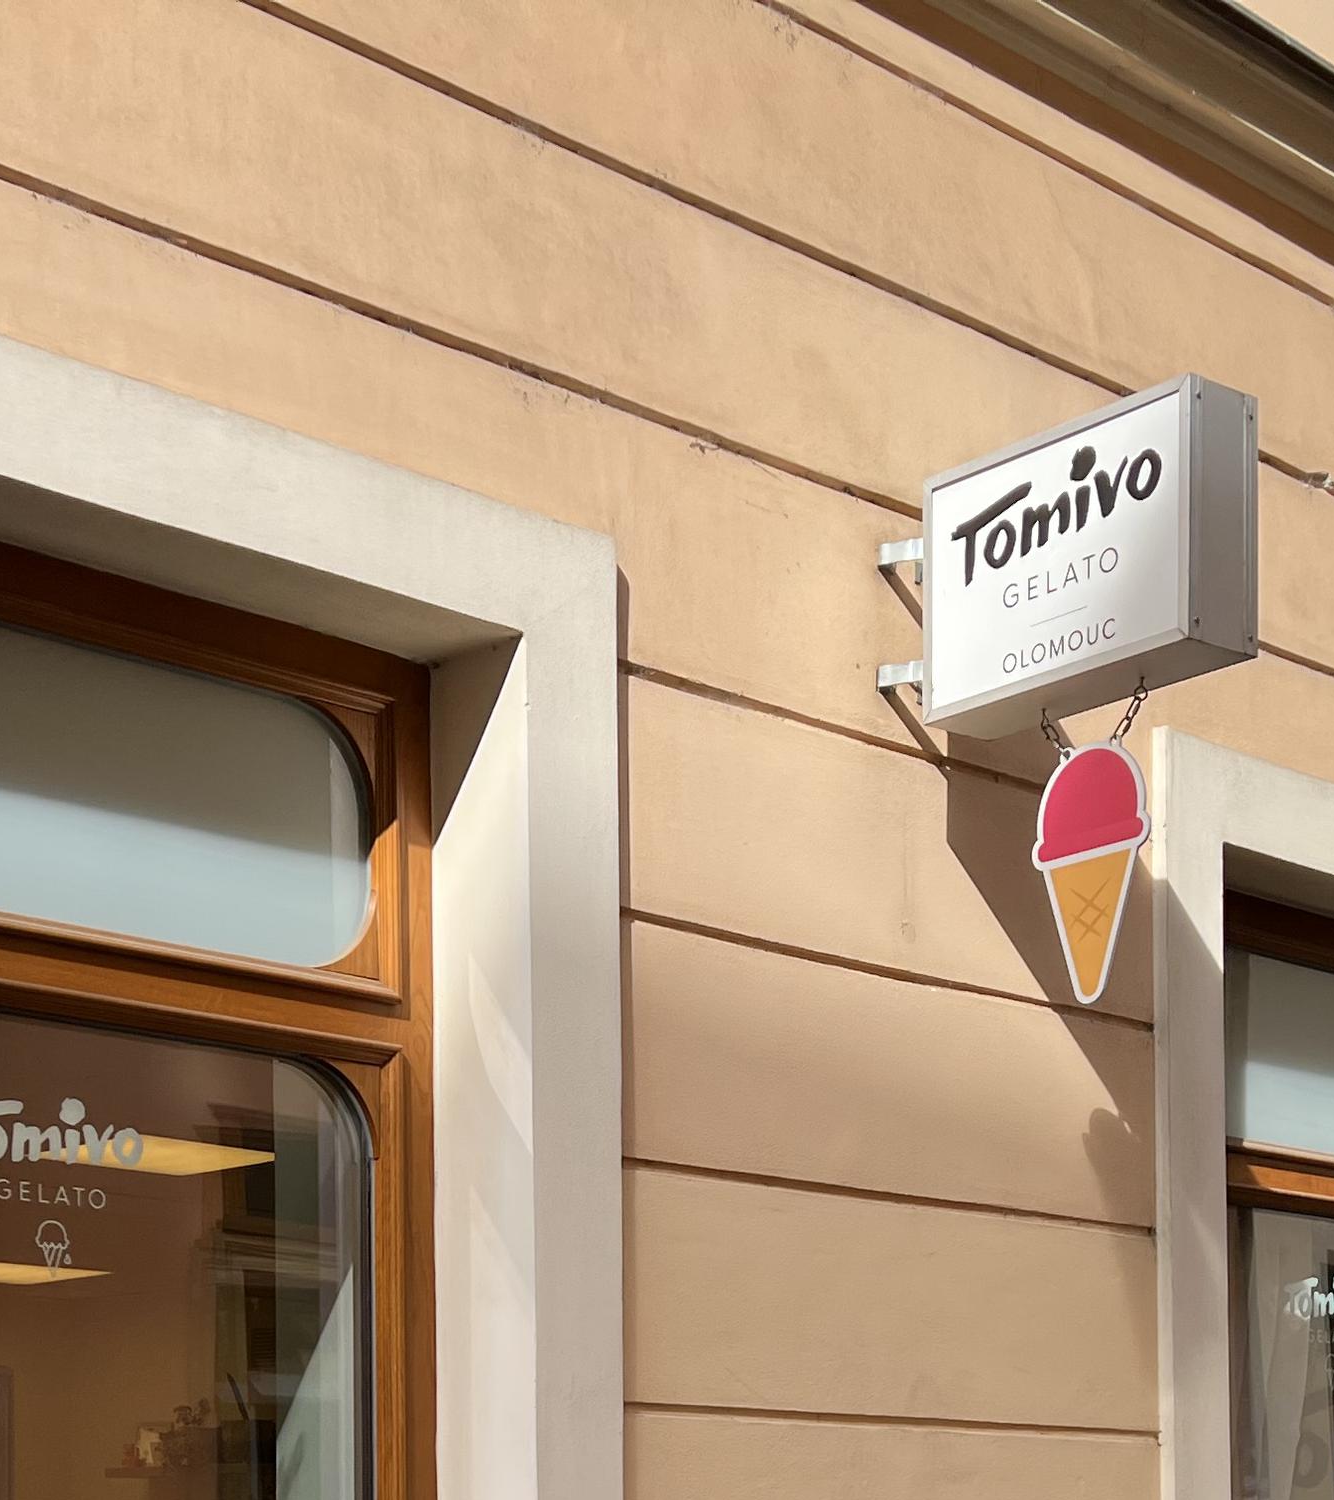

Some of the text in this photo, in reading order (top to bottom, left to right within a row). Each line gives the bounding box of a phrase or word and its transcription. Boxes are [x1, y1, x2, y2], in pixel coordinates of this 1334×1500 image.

[951, 445, 1163, 587] Tomivo
[1002, 547, 1119, 609] GELATO
[1002, 618, 1117, 675] OLOMOUC
